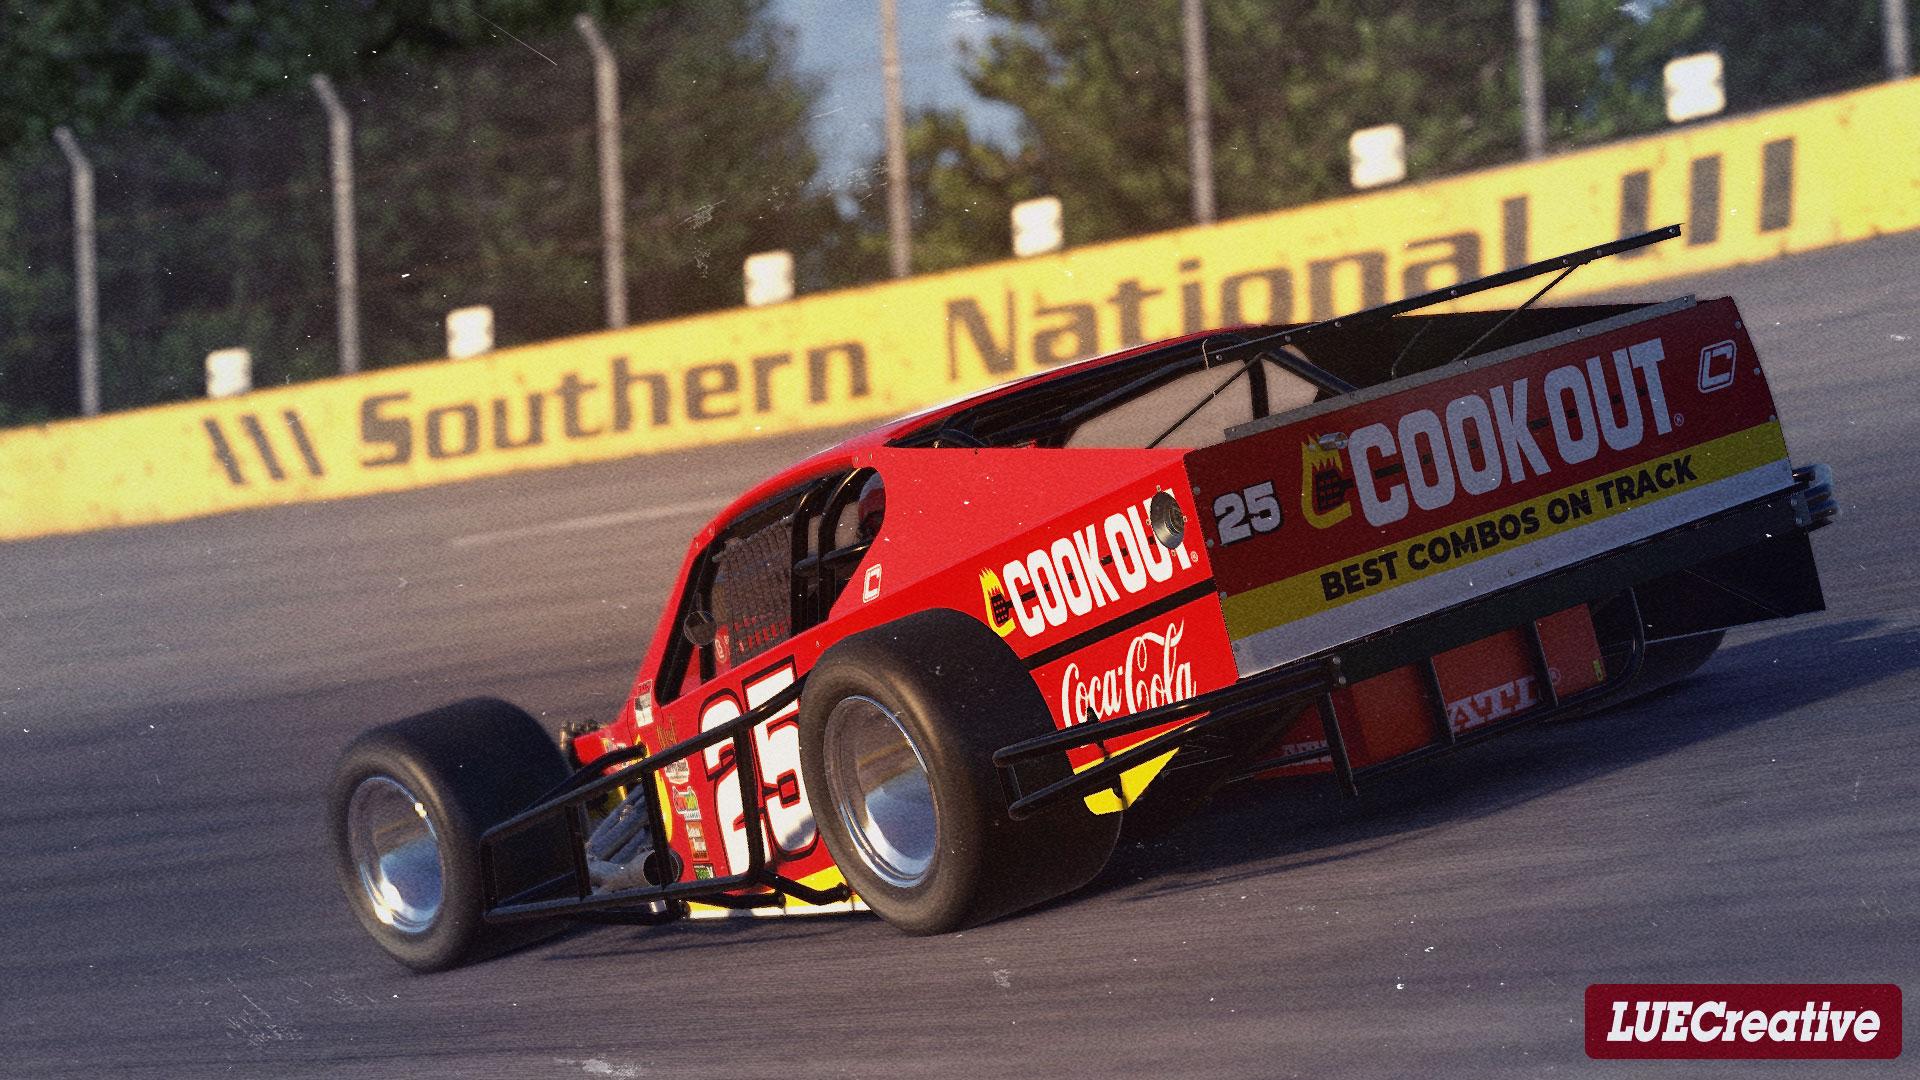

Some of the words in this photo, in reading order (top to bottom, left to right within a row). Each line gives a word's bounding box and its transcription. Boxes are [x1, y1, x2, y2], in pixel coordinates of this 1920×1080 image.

[360, 341, 869, 467] Southern
[946, 197, 1532, 382] National
[1213, 480, 1283, 545] 25
[1348, 378, 1551, 526] COOK
[1544, 337, 1673, 464] OUT
[1003, 524, 1120, 637] COOK
[1320, 552, 1399, 601] BEST
[1407, 513, 1540, 571] COMBOS
[1548, 489, 1592, 526] ON
[1601, 455, 1698, 512] TRACK
[699, 658, 819, 876] 25
